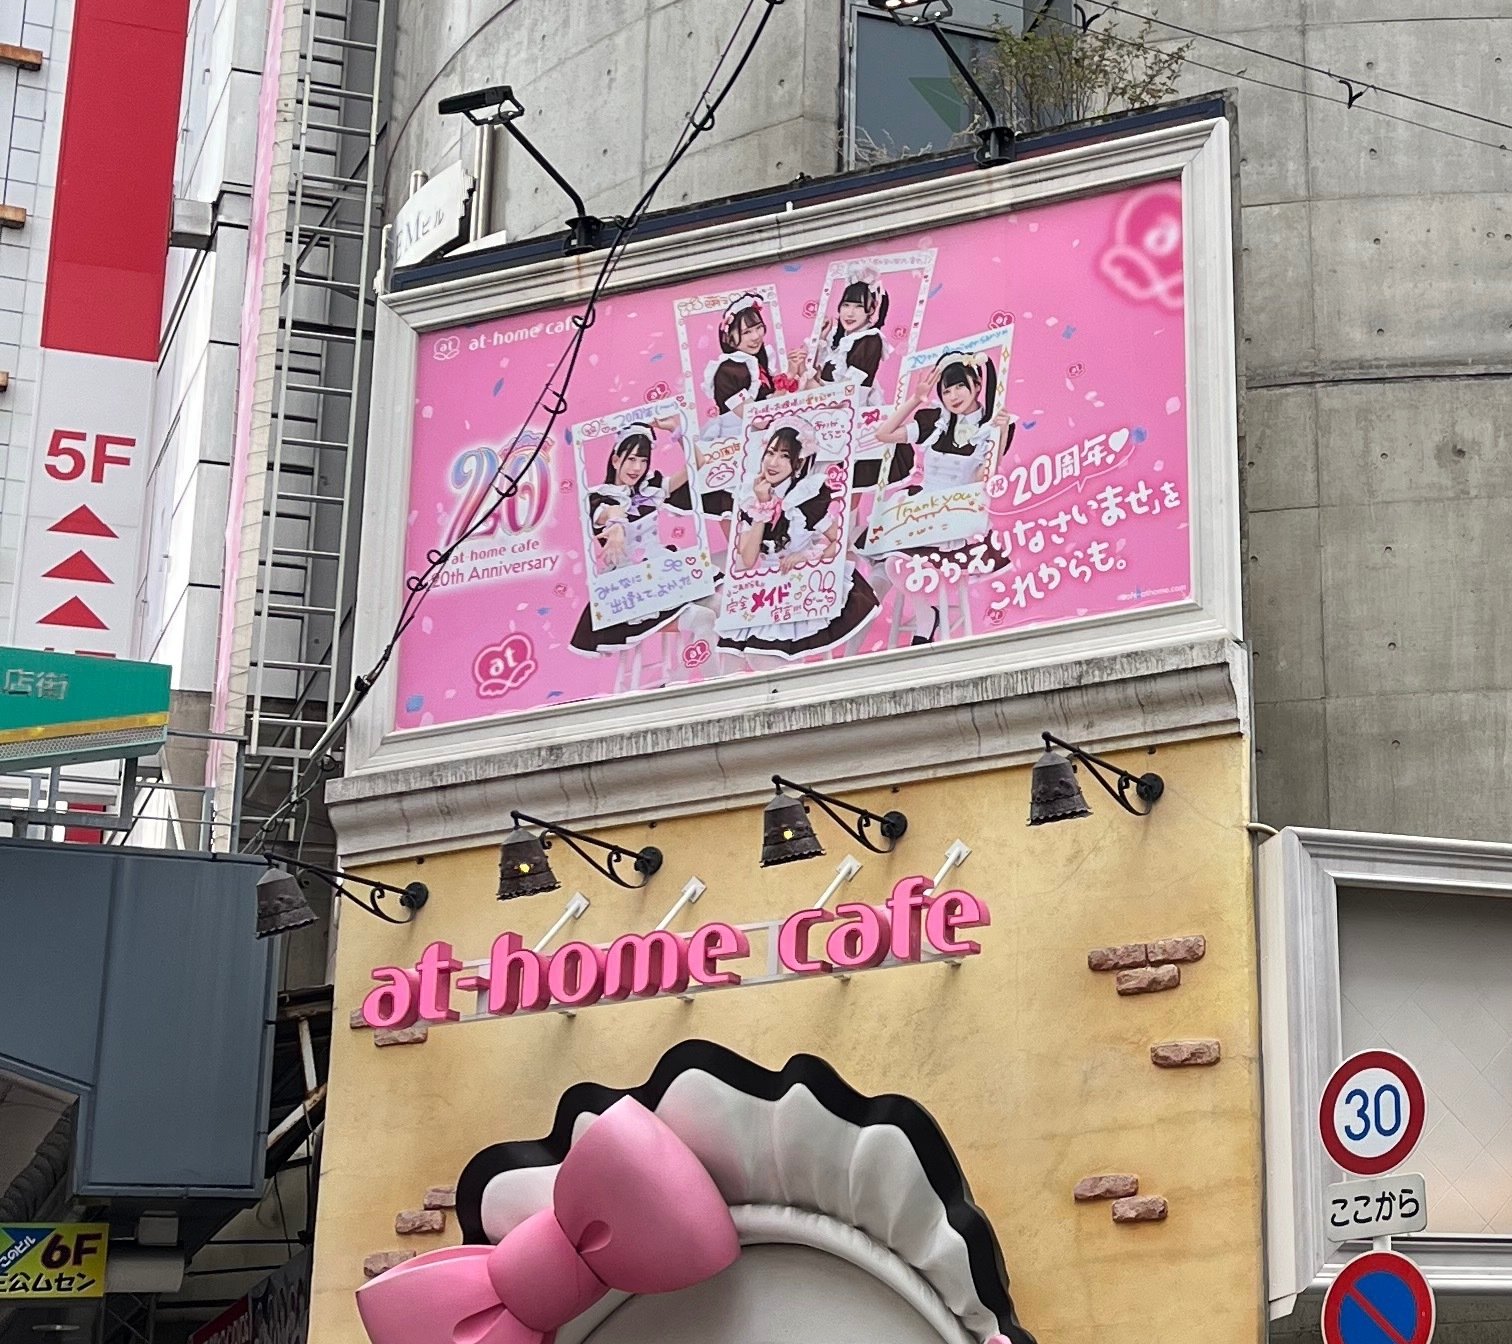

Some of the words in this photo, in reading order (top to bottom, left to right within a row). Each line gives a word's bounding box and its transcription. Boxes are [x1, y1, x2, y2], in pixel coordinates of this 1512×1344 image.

[468, 324, 540, 352] at-home
[43, 428, 137, 485] 5F
[1009, 434, 1108, 506] 20周年
[468, 554, 560, 583] Anniversary
[990, 540, 1128, 611] これからも。
[489, 647, 518, 677] at
[362, 921, 751, 1030] at-home
[778, 875, 991, 975] cafe
[1344, 1083, 1402, 1142] 30
[1331, 1188, 1421, 1229] ここから
[41, 1232, 103, 1270] 6F
